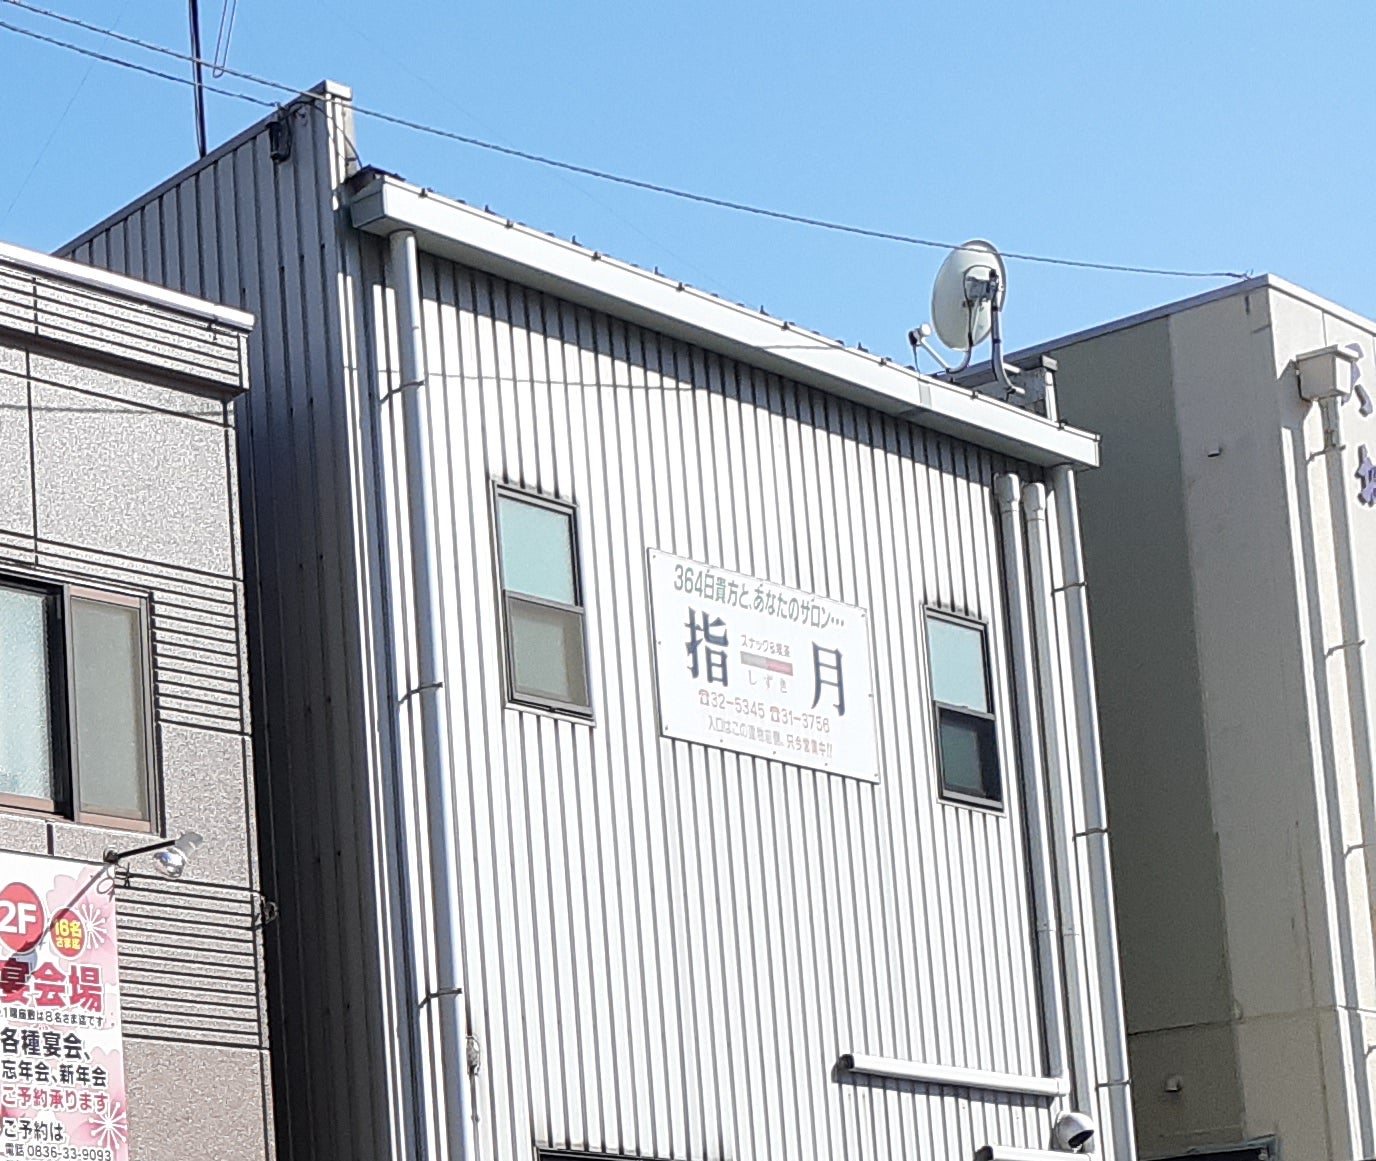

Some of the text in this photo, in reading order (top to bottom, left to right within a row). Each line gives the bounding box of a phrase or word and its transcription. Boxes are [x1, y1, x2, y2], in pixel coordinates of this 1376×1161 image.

[0, 1059, 108, 1088] 忘年会、新年会
[2, 1086, 109, 1113] ご予約承ります
[4, 1119, 64, 1142] ご予約は
